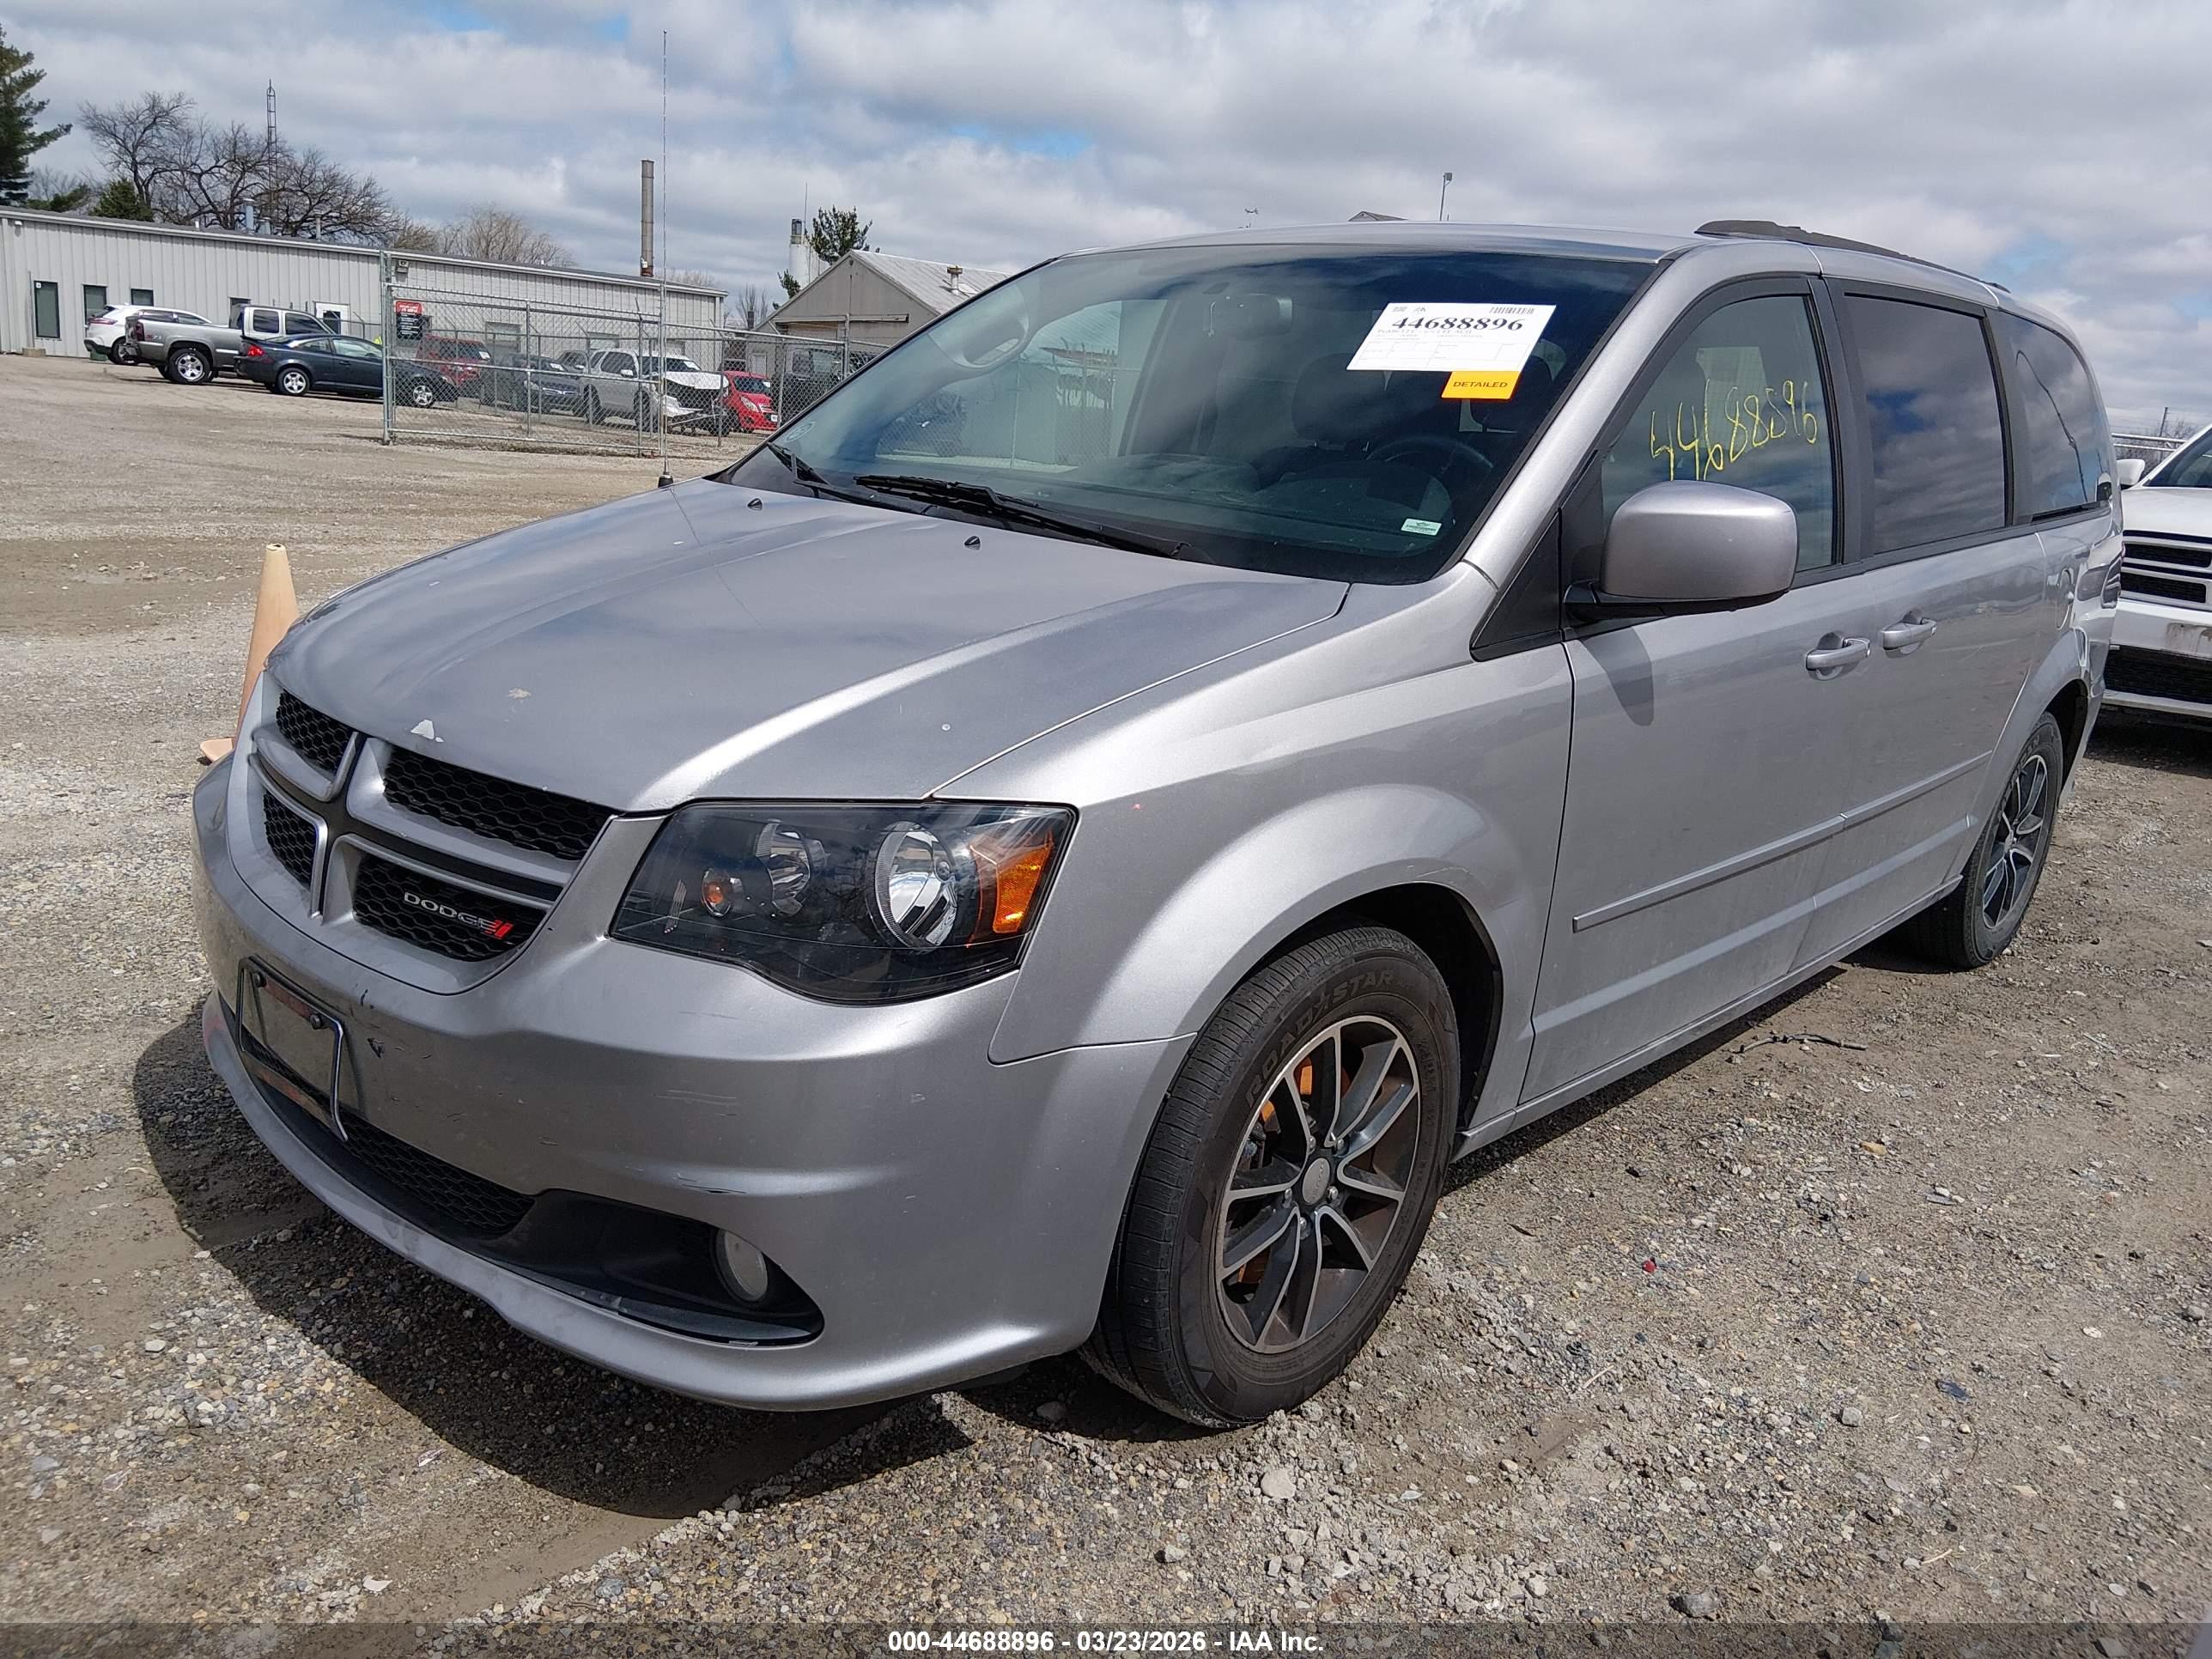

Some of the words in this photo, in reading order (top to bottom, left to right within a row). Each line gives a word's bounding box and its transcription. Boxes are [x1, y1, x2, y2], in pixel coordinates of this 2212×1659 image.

[1392, 316, 1525, 331] 44688896
[1452, 380, 1509, 389] DETAILED
[404, 891, 497, 933] DODGE
